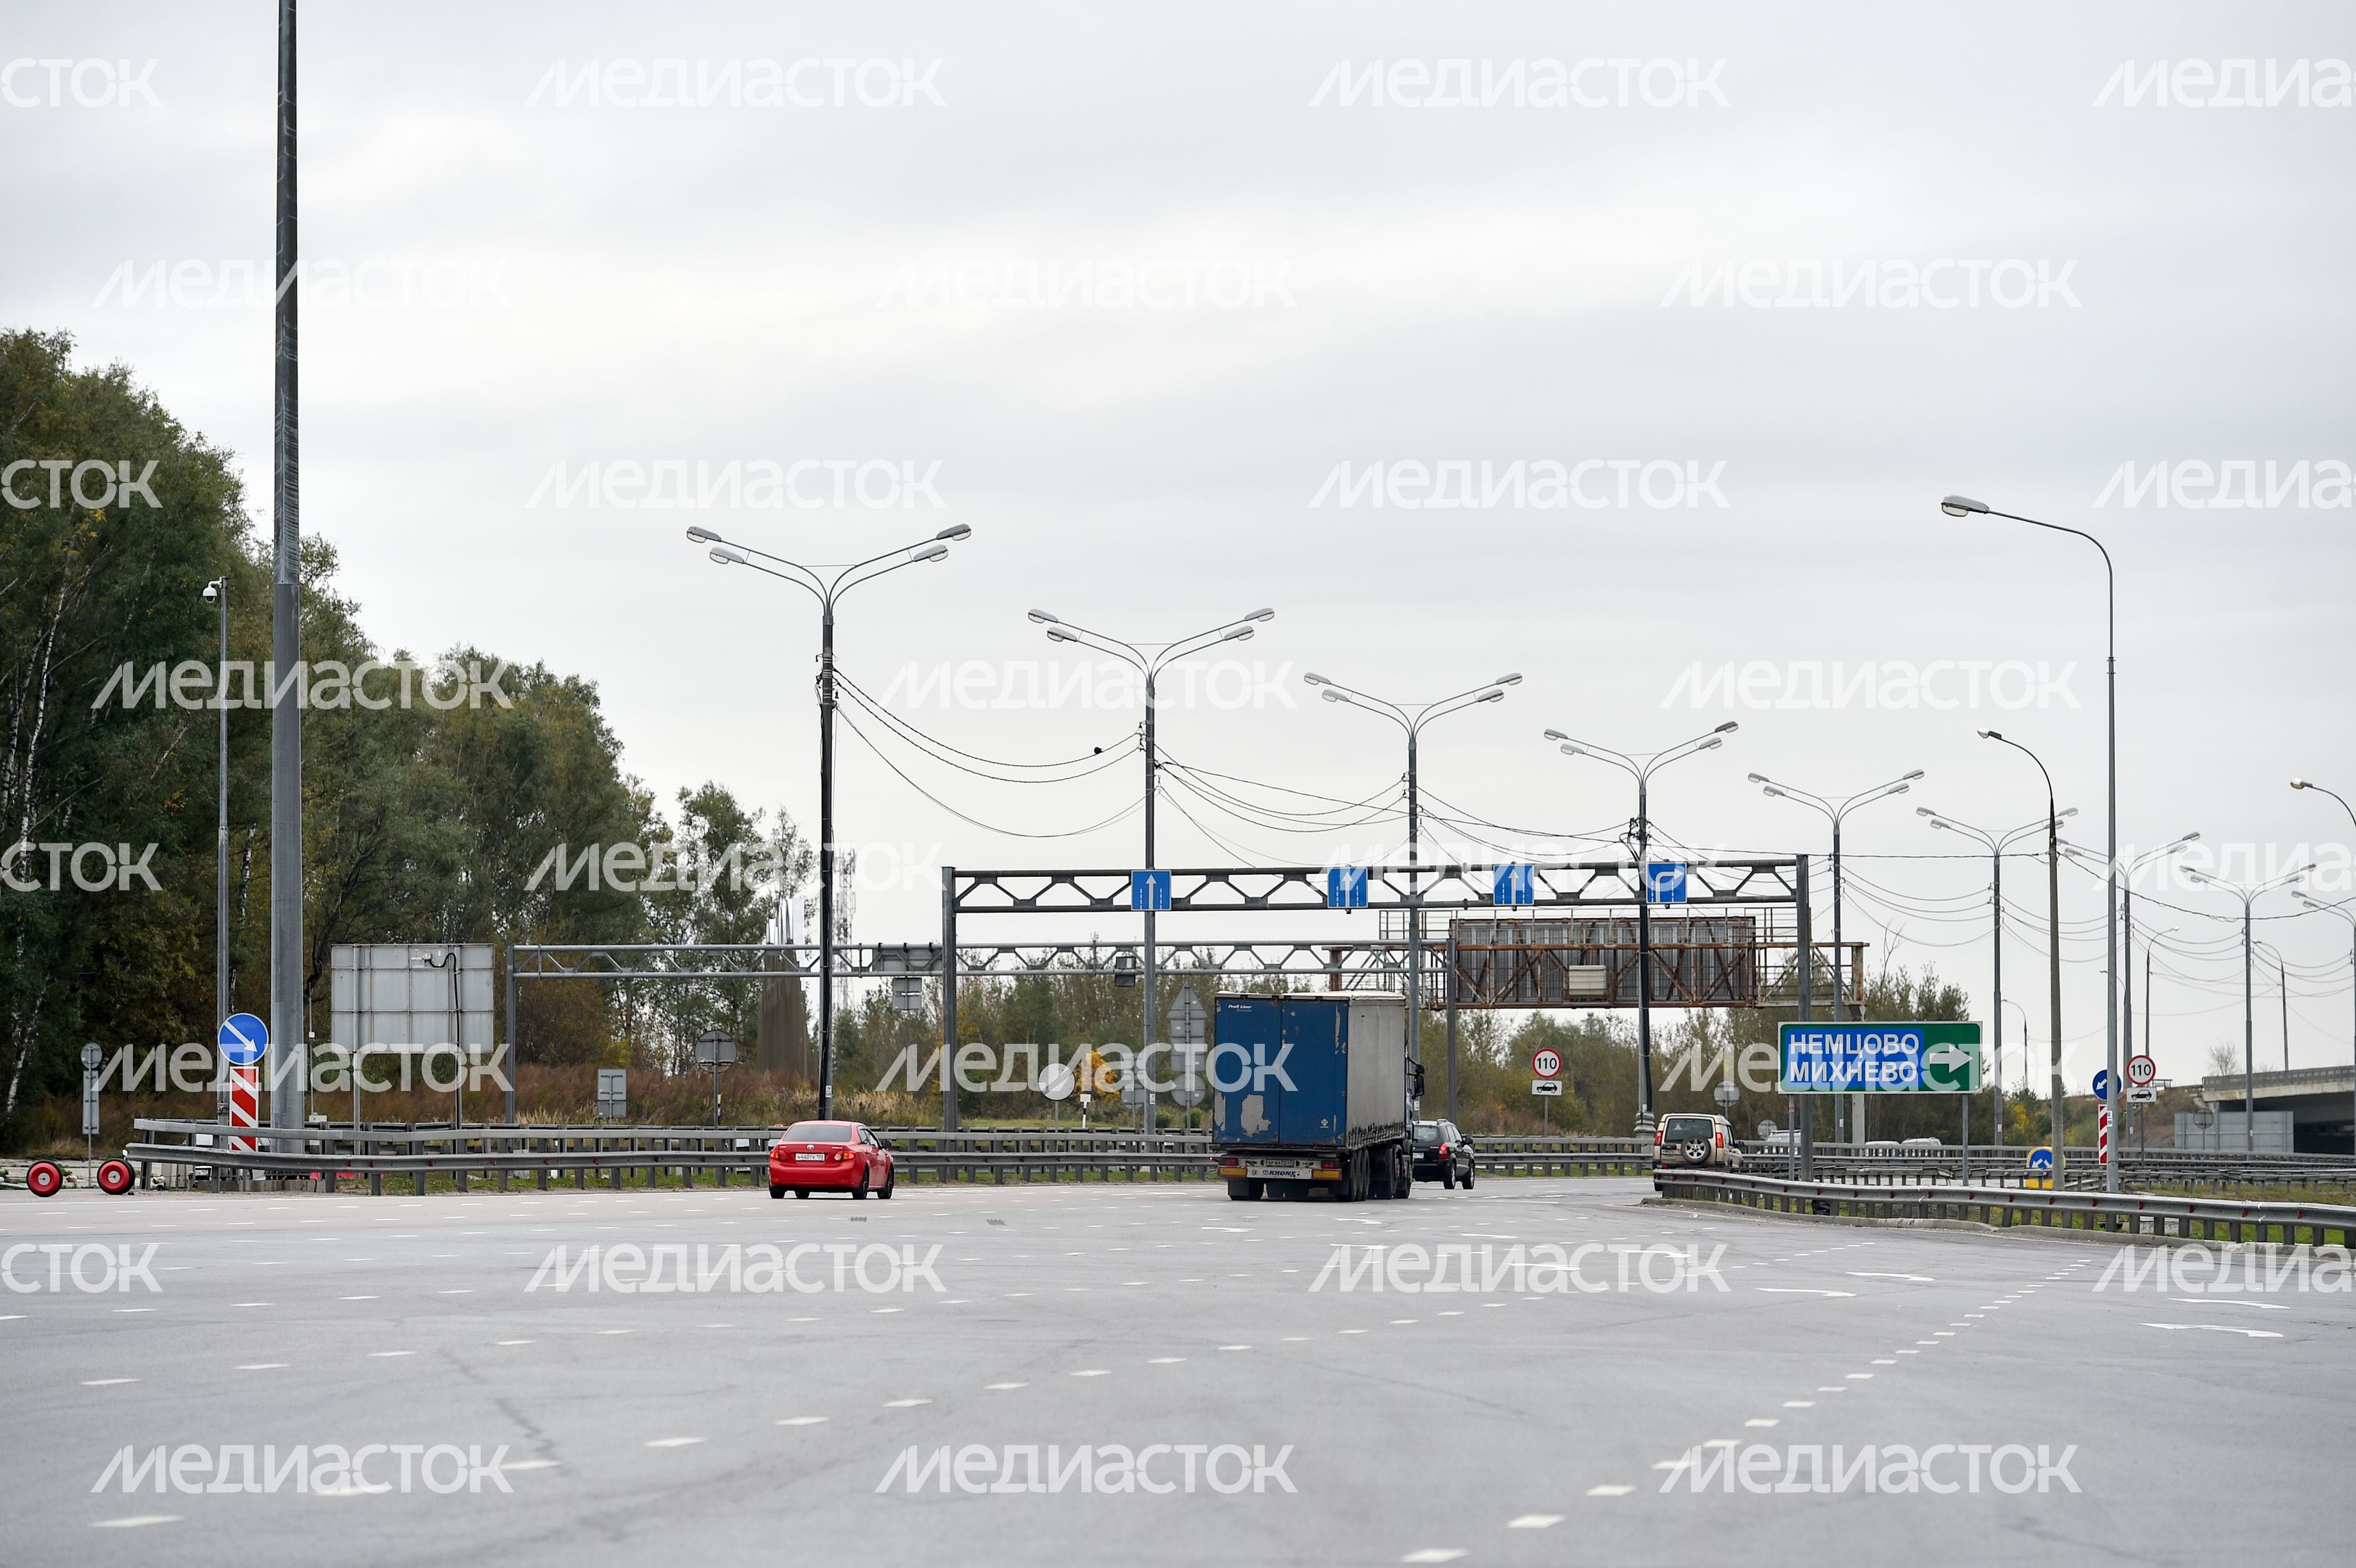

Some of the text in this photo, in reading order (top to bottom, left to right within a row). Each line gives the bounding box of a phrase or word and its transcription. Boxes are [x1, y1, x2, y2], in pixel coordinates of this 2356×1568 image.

[1790, 1034, 1919, 1058] НЕМЦОВО
[1537, 1058, 1557, 1069] 110
[1790, 1061, 1917, 1082] МИХНЕВО
[2131, 1064, 2151, 1076] 110
